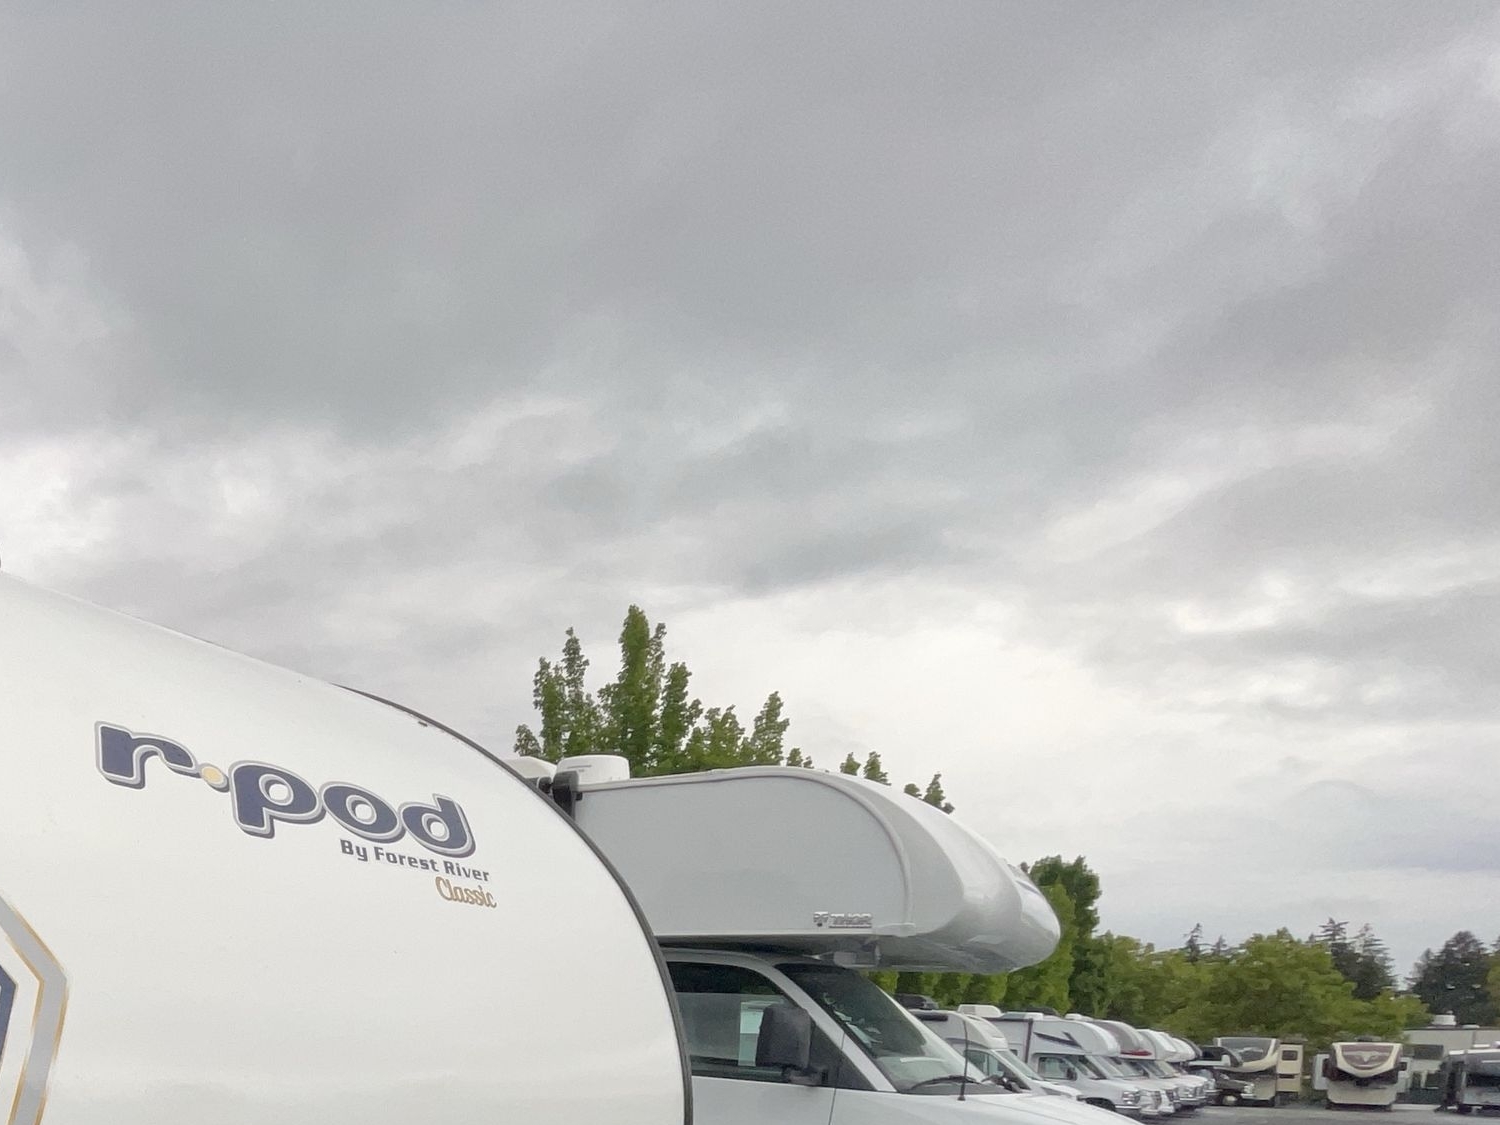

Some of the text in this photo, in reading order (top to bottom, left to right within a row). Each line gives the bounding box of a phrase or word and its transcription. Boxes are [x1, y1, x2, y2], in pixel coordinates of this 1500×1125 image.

[340, 839, 490, 882] By Forest River
[435, 876, 497, 908] Classic
